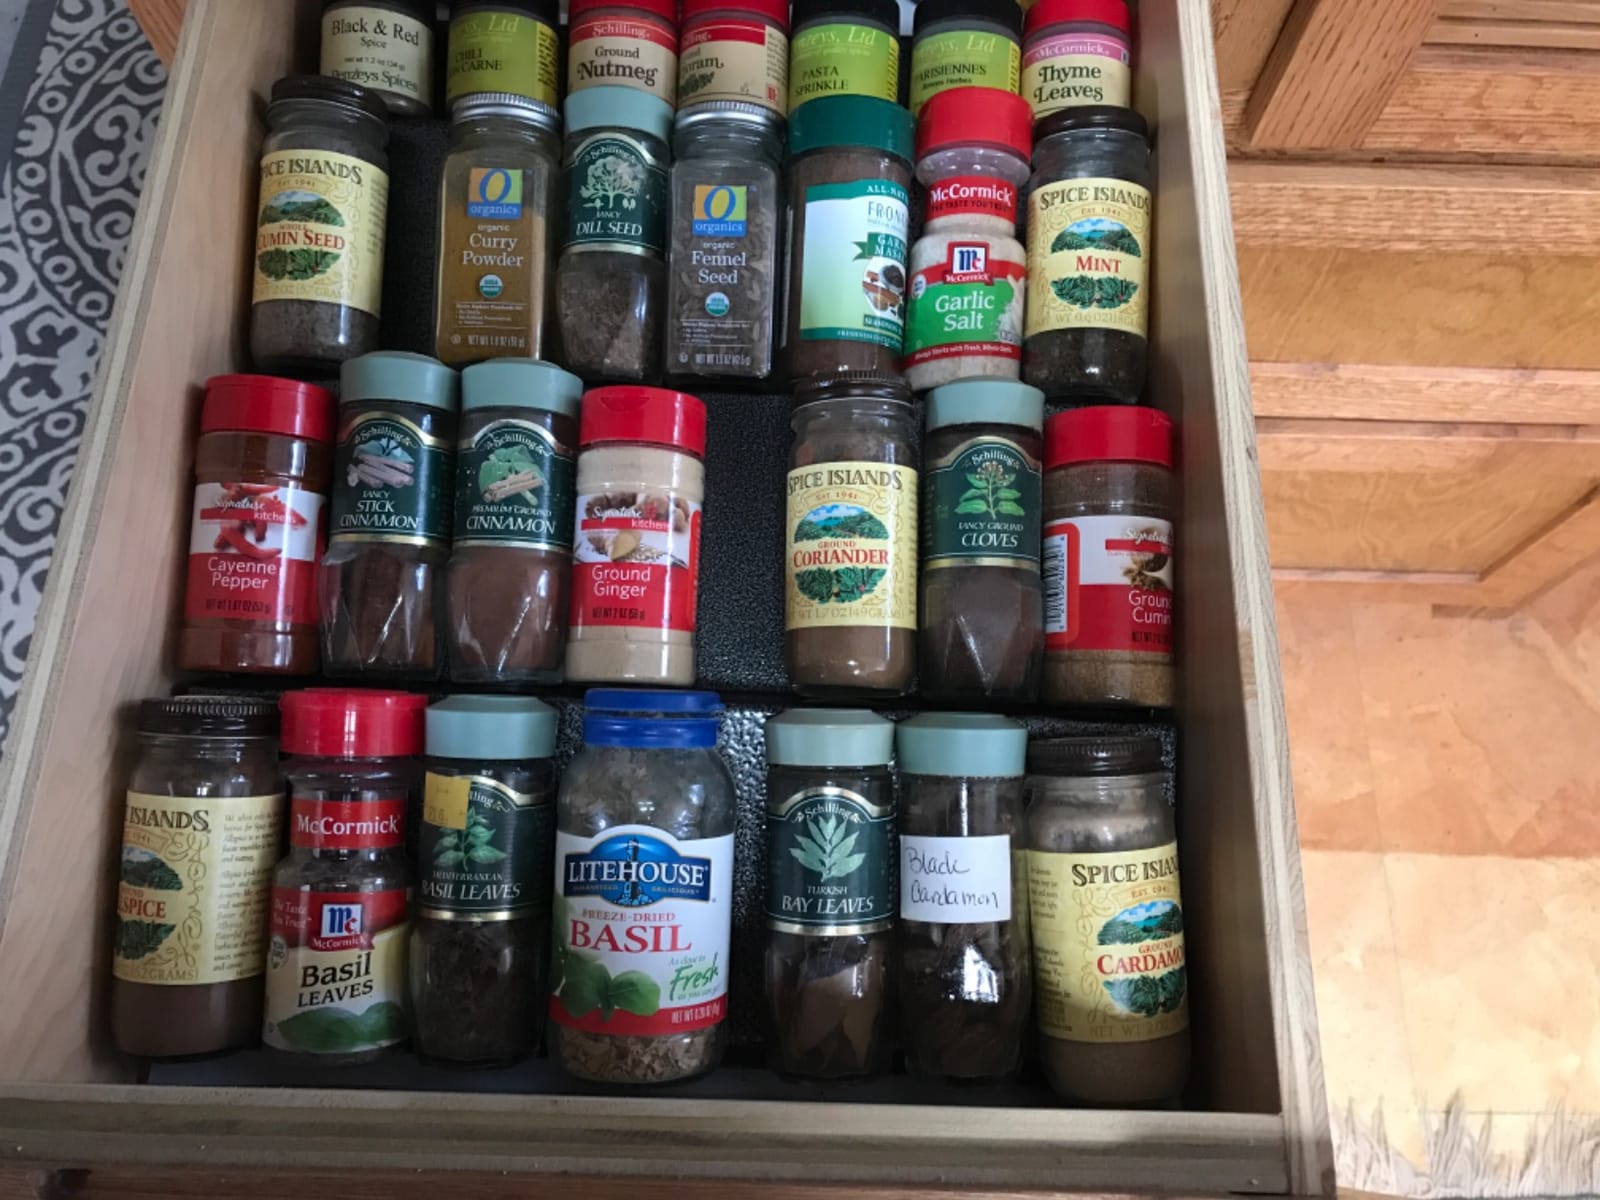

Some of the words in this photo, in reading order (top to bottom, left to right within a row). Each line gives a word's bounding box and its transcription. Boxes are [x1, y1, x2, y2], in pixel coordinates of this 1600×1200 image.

[332, 18, 368, 36] Black
[373, 20, 388, 36] &
[393, 23, 419, 46] Red
[489, 14, 520, 32] Ltd
[592, 23, 656, 39] Schilling
[360, 37, 387, 48] Spice
[848, 26, 876, 45] Ltd
[968, 34, 997, 53] Ltd
[594, 46, 640, 59] Ground
[1036, 42, 1103, 58] McCormick
[460, 59, 503, 72] CARNE
[577, 60, 658, 87] Nutmeg
[802, 65, 839, 80] PASTA
[1038, 65, 1102, 83] Thyme
[381, 70, 418, 92] Spices
[1033, 85, 1104, 104] Leaves
[289, 159, 363, 185] ISLANDS
[930, 183, 1013, 207] McCormick
[1039, 186, 1090, 211] SPICE
[1094, 186, 1150, 216] ISLANDS
[470, 203, 518, 217] organics
[478, 223, 511, 232] organic
[576, 221, 604, 236] DILL
[608, 221, 643, 236] SEED
[695, 221, 743, 234] organics
[303, 229, 346, 249] SEED
[469, 232, 518, 251] Curry
[703, 241, 737, 251] organic
[462, 250, 525, 267] Powder
[691, 250, 748, 268] Fennel
[1075, 255, 1122, 274] MINT
[697, 268, 739, 284] Seed
[945, 272, 990, 283] McCormick
[935, 289, 996, 313] Garlic
[943, 310, 985, 332] Salt
[493, 433, 537, 451] Schilling
[971, 450, 1014, 466] Schilling
[788, 471, 823, 496] SPICE
[827, 469, 904, 490] ISLANDS
[362, 490, 391, 499] FANCY
[355, 500, 395, 513] STICK
[340, 514, 419, 529] CINNAMON
[466, 515, 557, 535] CINNAMON
[958, 521, 985, 530] FANCY
[987, 521, 1024, 531] GROUND
[818, 541, 857, 549] GROUND
[961, 532, 1019, 547] CLOVES
[207, 556, 277, 575] Cayenne
[793, 549, 890, 568] CORIANDER
[211, 571, 269, 592] Pepper
[592, 565, 652, 581] Ground
[593, 581, 648, 600] Ginger
[1132, 606, 1171, 625] Cumin
[469, 790, 494, 808] lling
[129, 807, 209, 832] ISLANDS
[805, 802, 850, 819] Schilling
[297, 814, 399, 834] McCormick
[905, 846, 971, 876] Black
[568, 861, 704, 888] LITEHOUSE
[1071, 863, 1139, 888] SPICE
[422, 880, 456, 899] BASIL
[459, 882, 521, 901] LEAVES
[807, 885, 848, 896] TURKISH
[120, 896, 167, 918] SPICE
[582, 907, 676, 921] FREEZE-DRIED
[782, 895, 813, 912] BAY
[816, 895, 875, 915] LEAVES
[312, 934, 368, 950] McCormick
[568, 919, 693, 954] BASIL
[301, 951, 371, 988] Basil
[669, 951, 719, 1001] Fresh
[297, 979, 375, 1008] LEAVES
